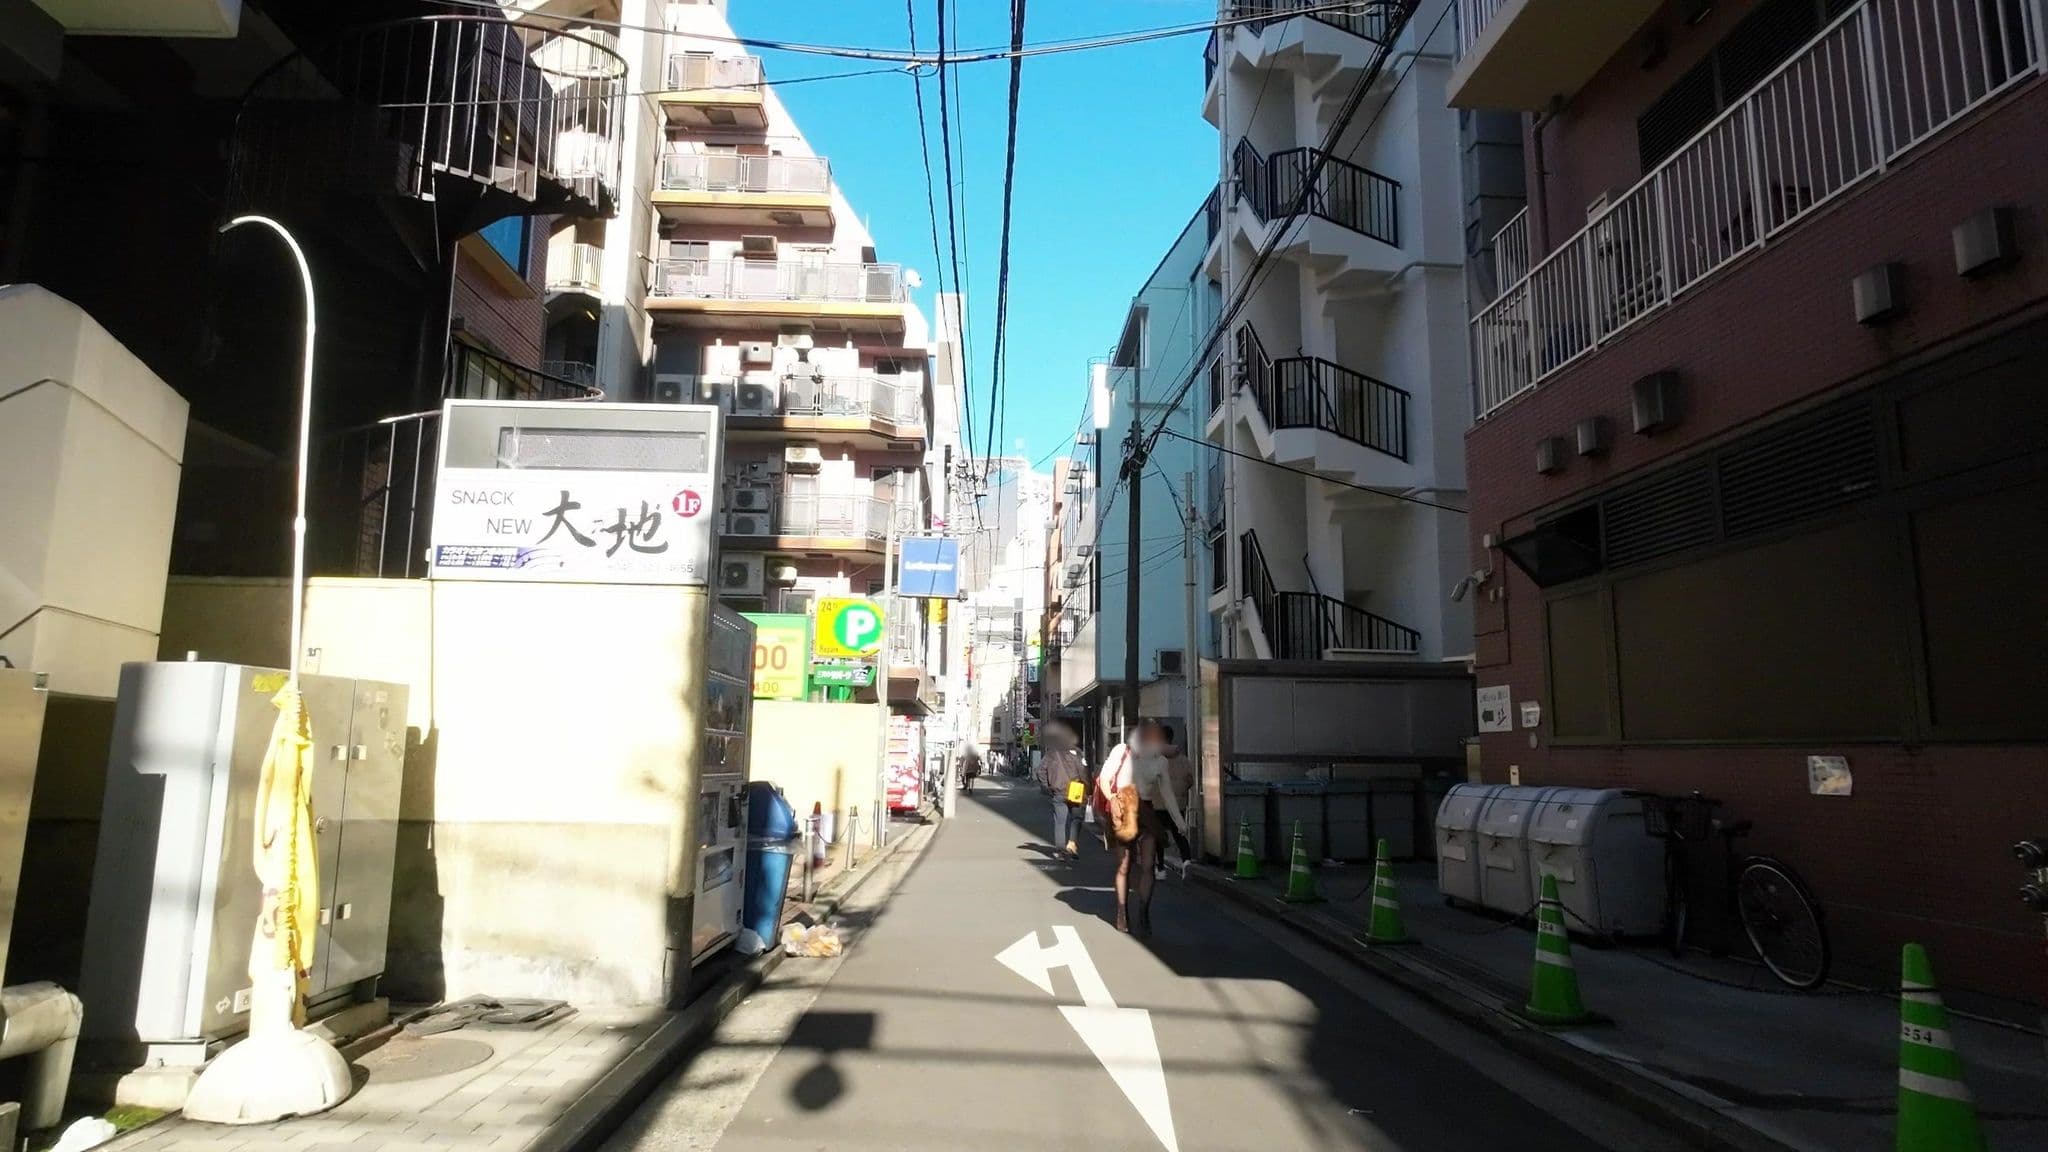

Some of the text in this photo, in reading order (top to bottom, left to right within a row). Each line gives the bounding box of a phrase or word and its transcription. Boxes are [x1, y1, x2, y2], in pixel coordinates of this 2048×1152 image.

[451, 489, 515, 506] SNACK
[486, 518, 533, 535] NEW
[536, 490, 669, 558] 大地
[845, 609, 876, 647] P
